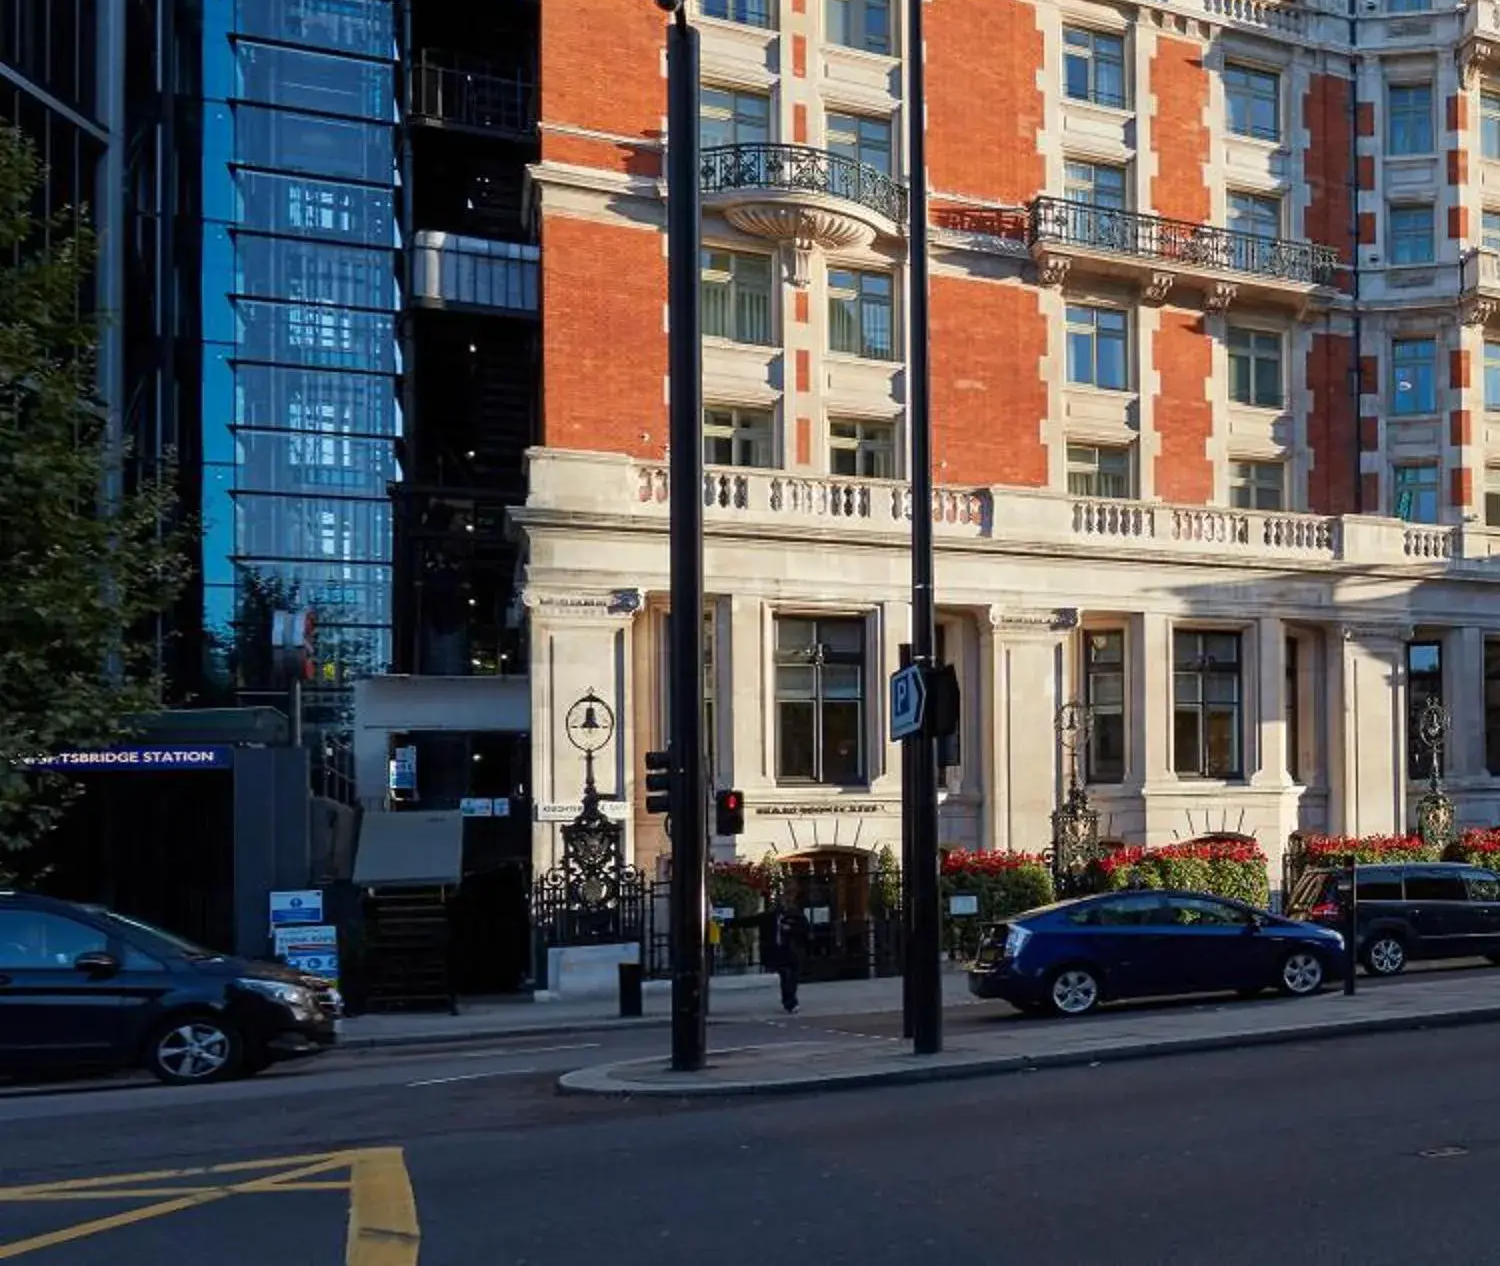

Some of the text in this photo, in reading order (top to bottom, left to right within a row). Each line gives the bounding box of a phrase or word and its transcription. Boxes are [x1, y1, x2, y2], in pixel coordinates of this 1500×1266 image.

[898, 681, 906, 714] P
[10, 751, 214, 765] TSBRIDGE STATION
